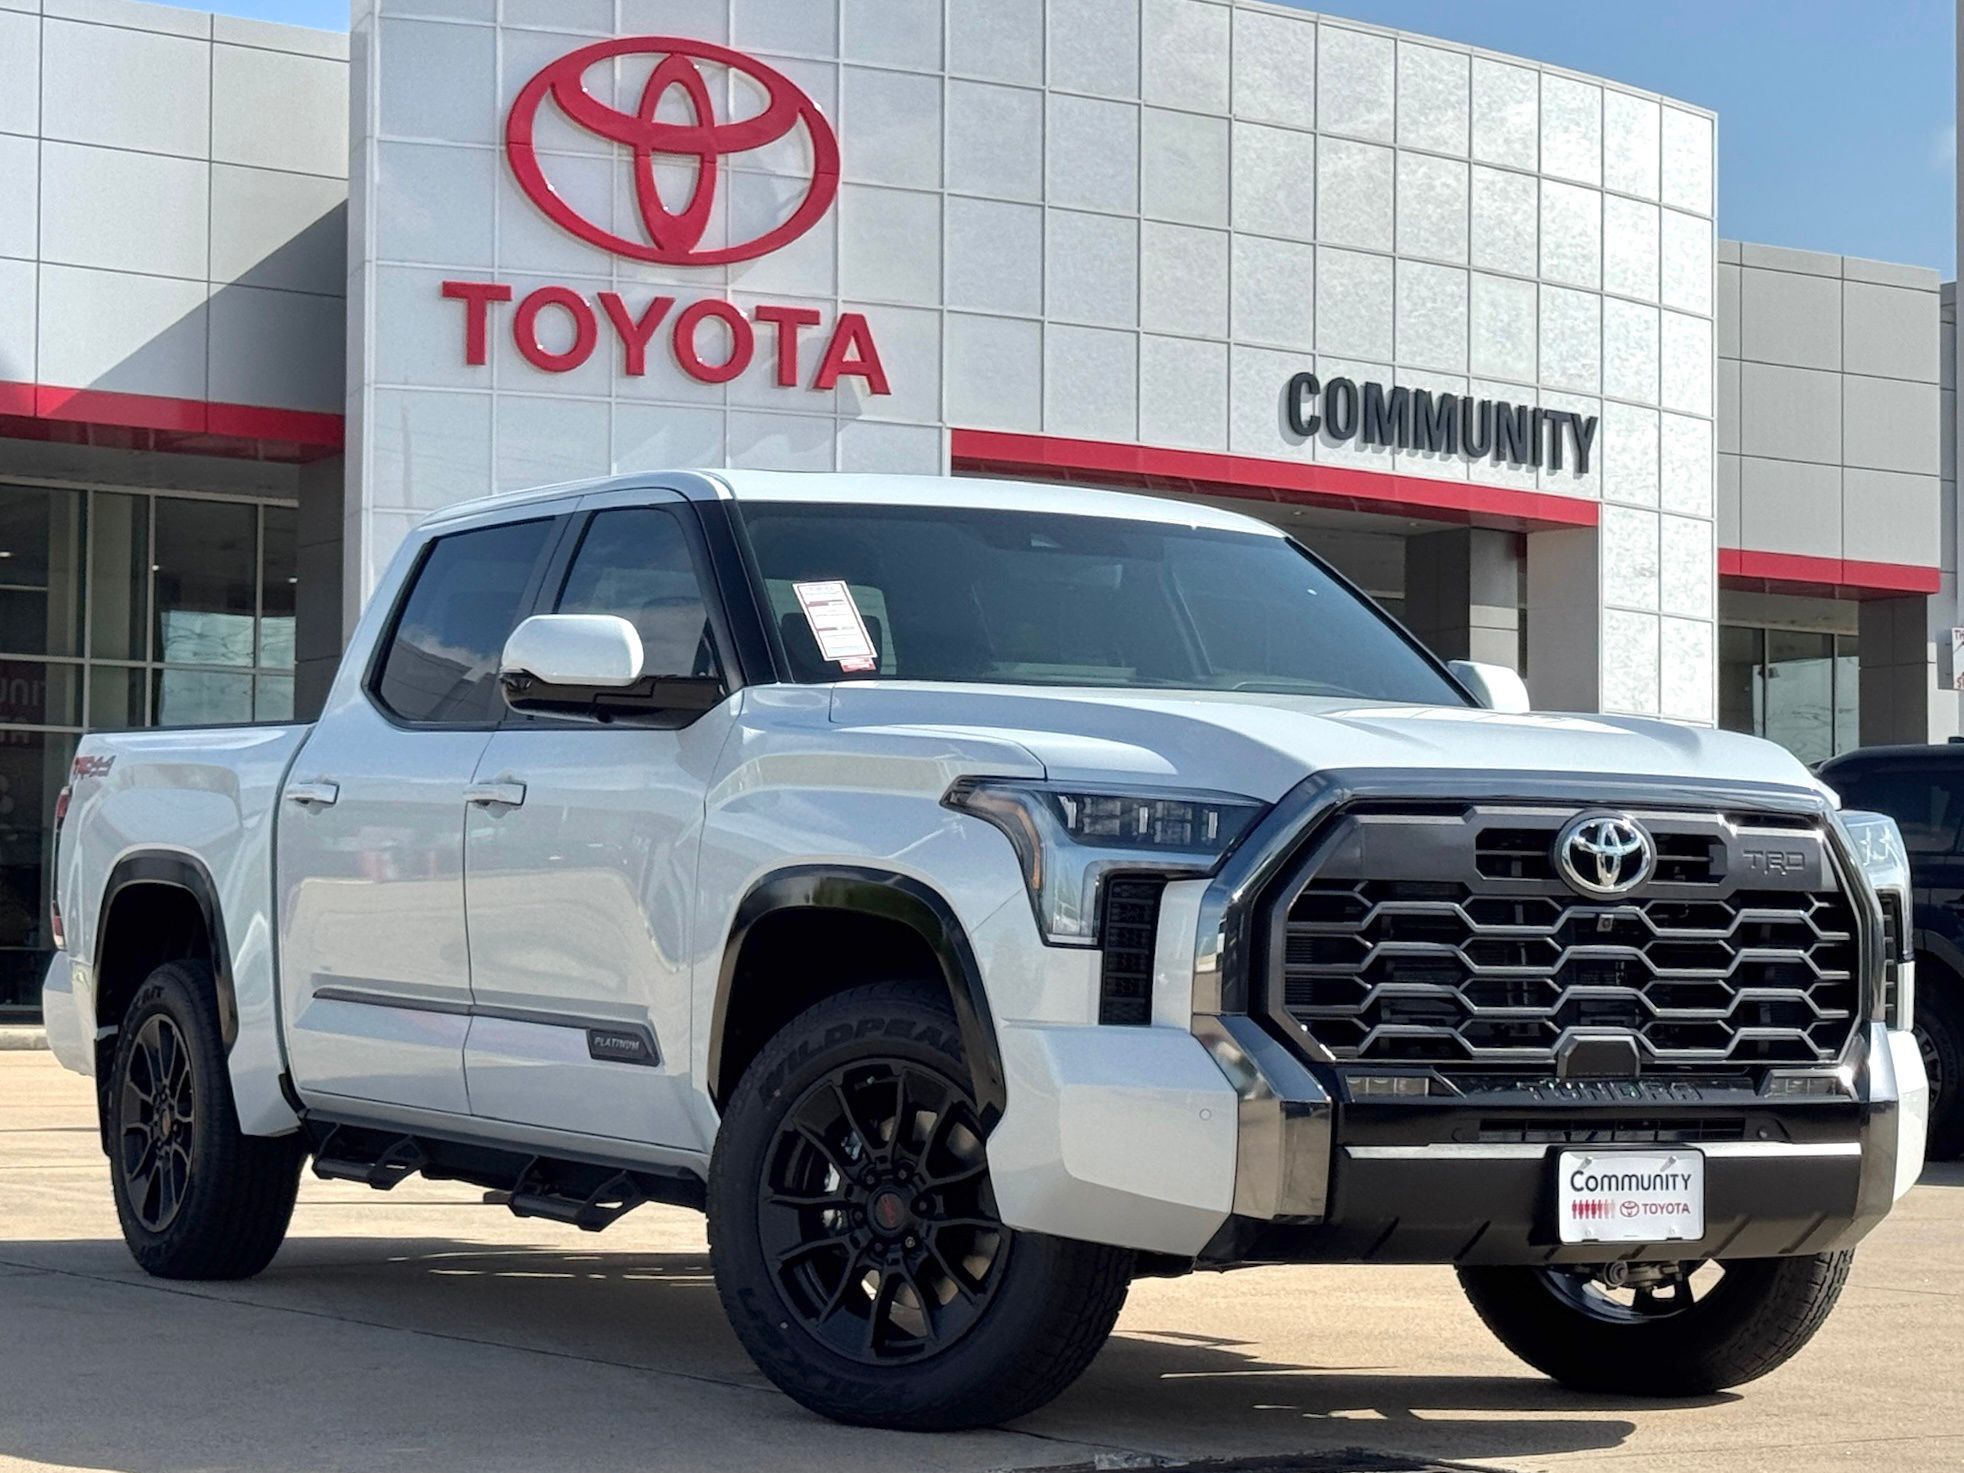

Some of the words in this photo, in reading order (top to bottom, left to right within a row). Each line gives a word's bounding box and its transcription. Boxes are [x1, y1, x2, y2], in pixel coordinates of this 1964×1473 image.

[442, 281, 891, 396] TOYOTA
[1287, 372, 1598, 474] COMMUNITY
[1743, 850, 1806, 875] TRD
[594, 1037, 640, 1051] PLATINUM
[1516, 1078, 1703, 1100] TUNDRA
[1642, 1203, 1691, 1215] TOYOTA
